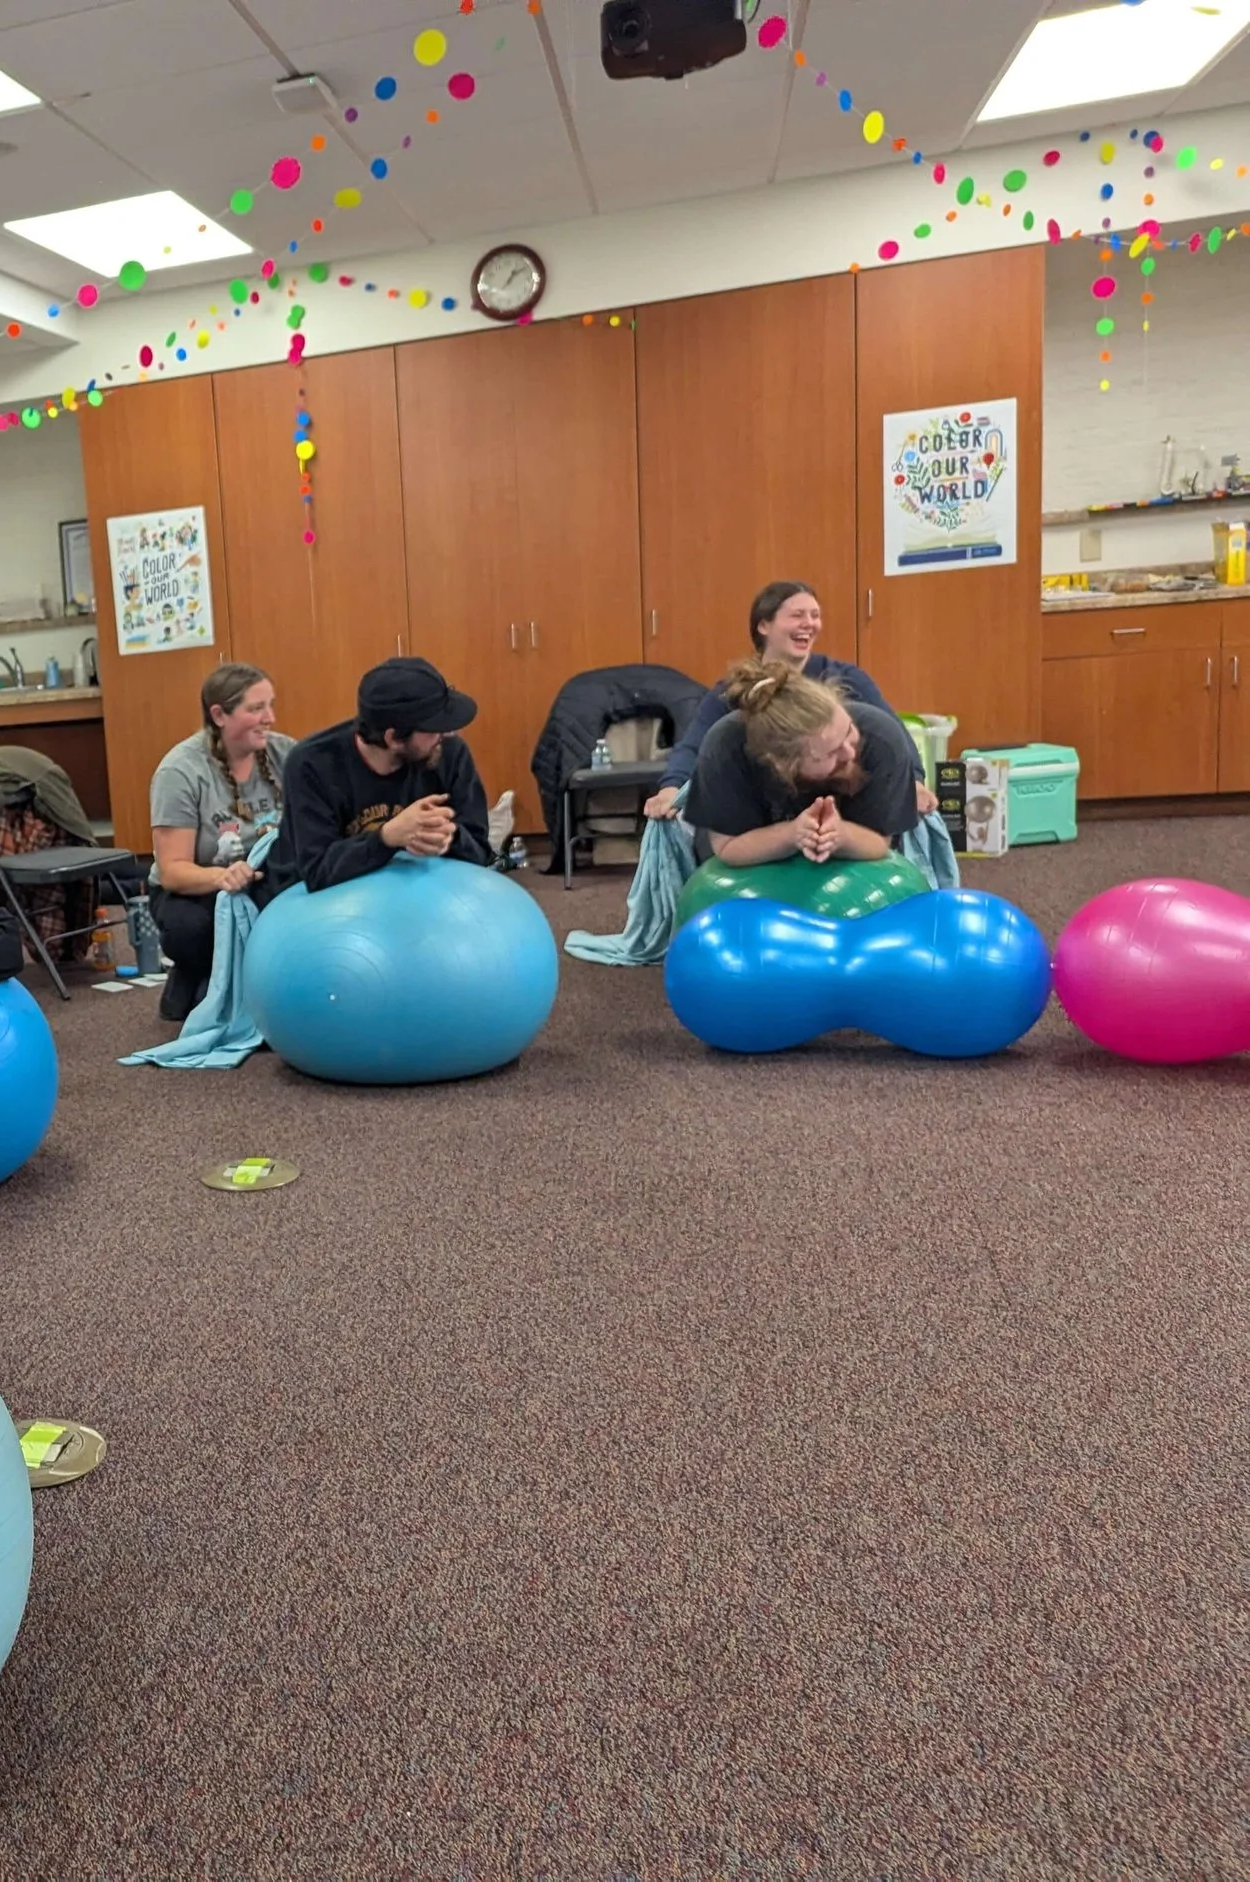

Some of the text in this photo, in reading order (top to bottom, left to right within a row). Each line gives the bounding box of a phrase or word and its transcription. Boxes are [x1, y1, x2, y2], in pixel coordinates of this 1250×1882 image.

[919, 428, 983, 454] COLOR
[931, 456, 970, 478] OUR
[918, 480, 986, 504] WORLD
[142, 552, 177, 580] COLOR
[151, 572, 170, 585] OUR
[144, 579, 180, 606] WORLD
